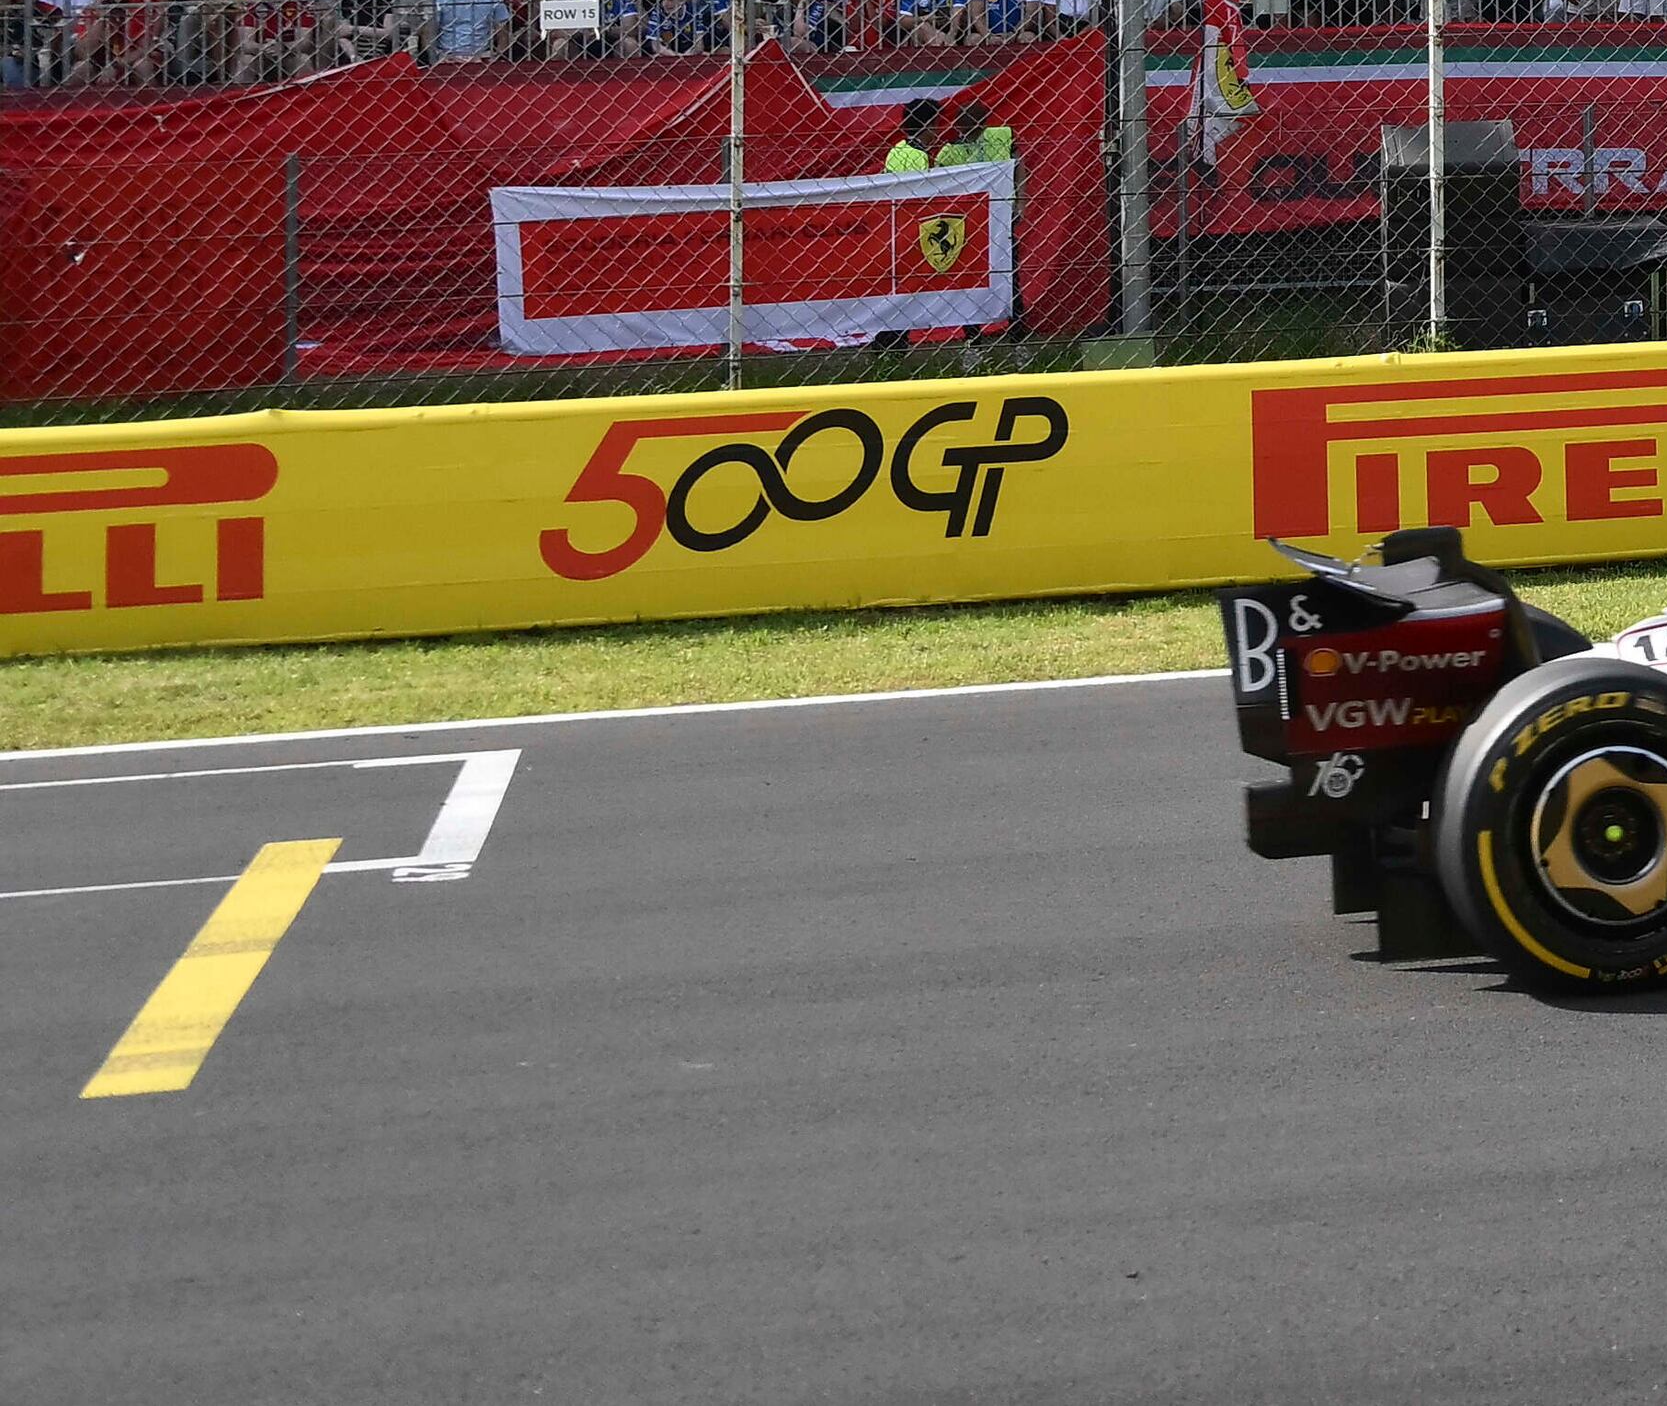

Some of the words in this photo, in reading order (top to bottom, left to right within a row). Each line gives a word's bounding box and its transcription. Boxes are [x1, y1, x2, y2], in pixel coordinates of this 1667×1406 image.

[543, 8, 576, 22] ROW
[581, 8, 597, 22] 15
[539, 396, 1070, 581] 500GP
[1342, 649, 1487, 675] V-Power
